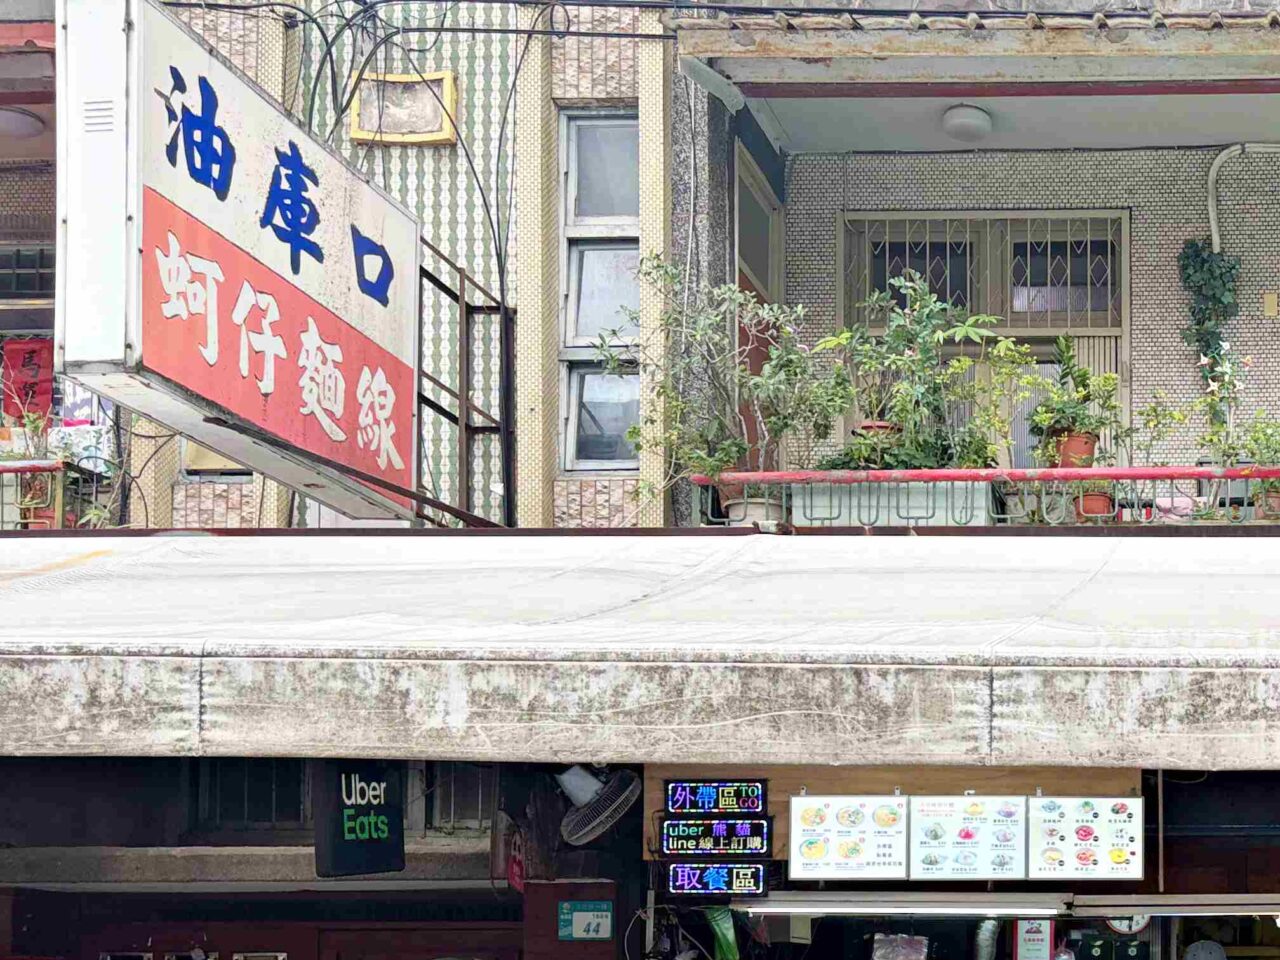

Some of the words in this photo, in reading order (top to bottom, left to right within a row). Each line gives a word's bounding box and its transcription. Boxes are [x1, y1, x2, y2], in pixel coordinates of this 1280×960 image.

[154, 65, 396, 308] 油庫口
[155, 230, 405, 472] 蚵仔麵線
[341, 773, 387, 806] Uber
[673, 786, 738, 809] 外帶區
[740, 786, 758, 797] TO
[739, 797, 758, 808] GO
[343, 808, 388, 840] Eats
[669, 824, 705, 836] uber
[669, 837, 696, 849] line
[698, 836, 762, 850] 線上訂購
[675, 867, 757, 890] 取餐區
[583, 921, 601, 935] 44
